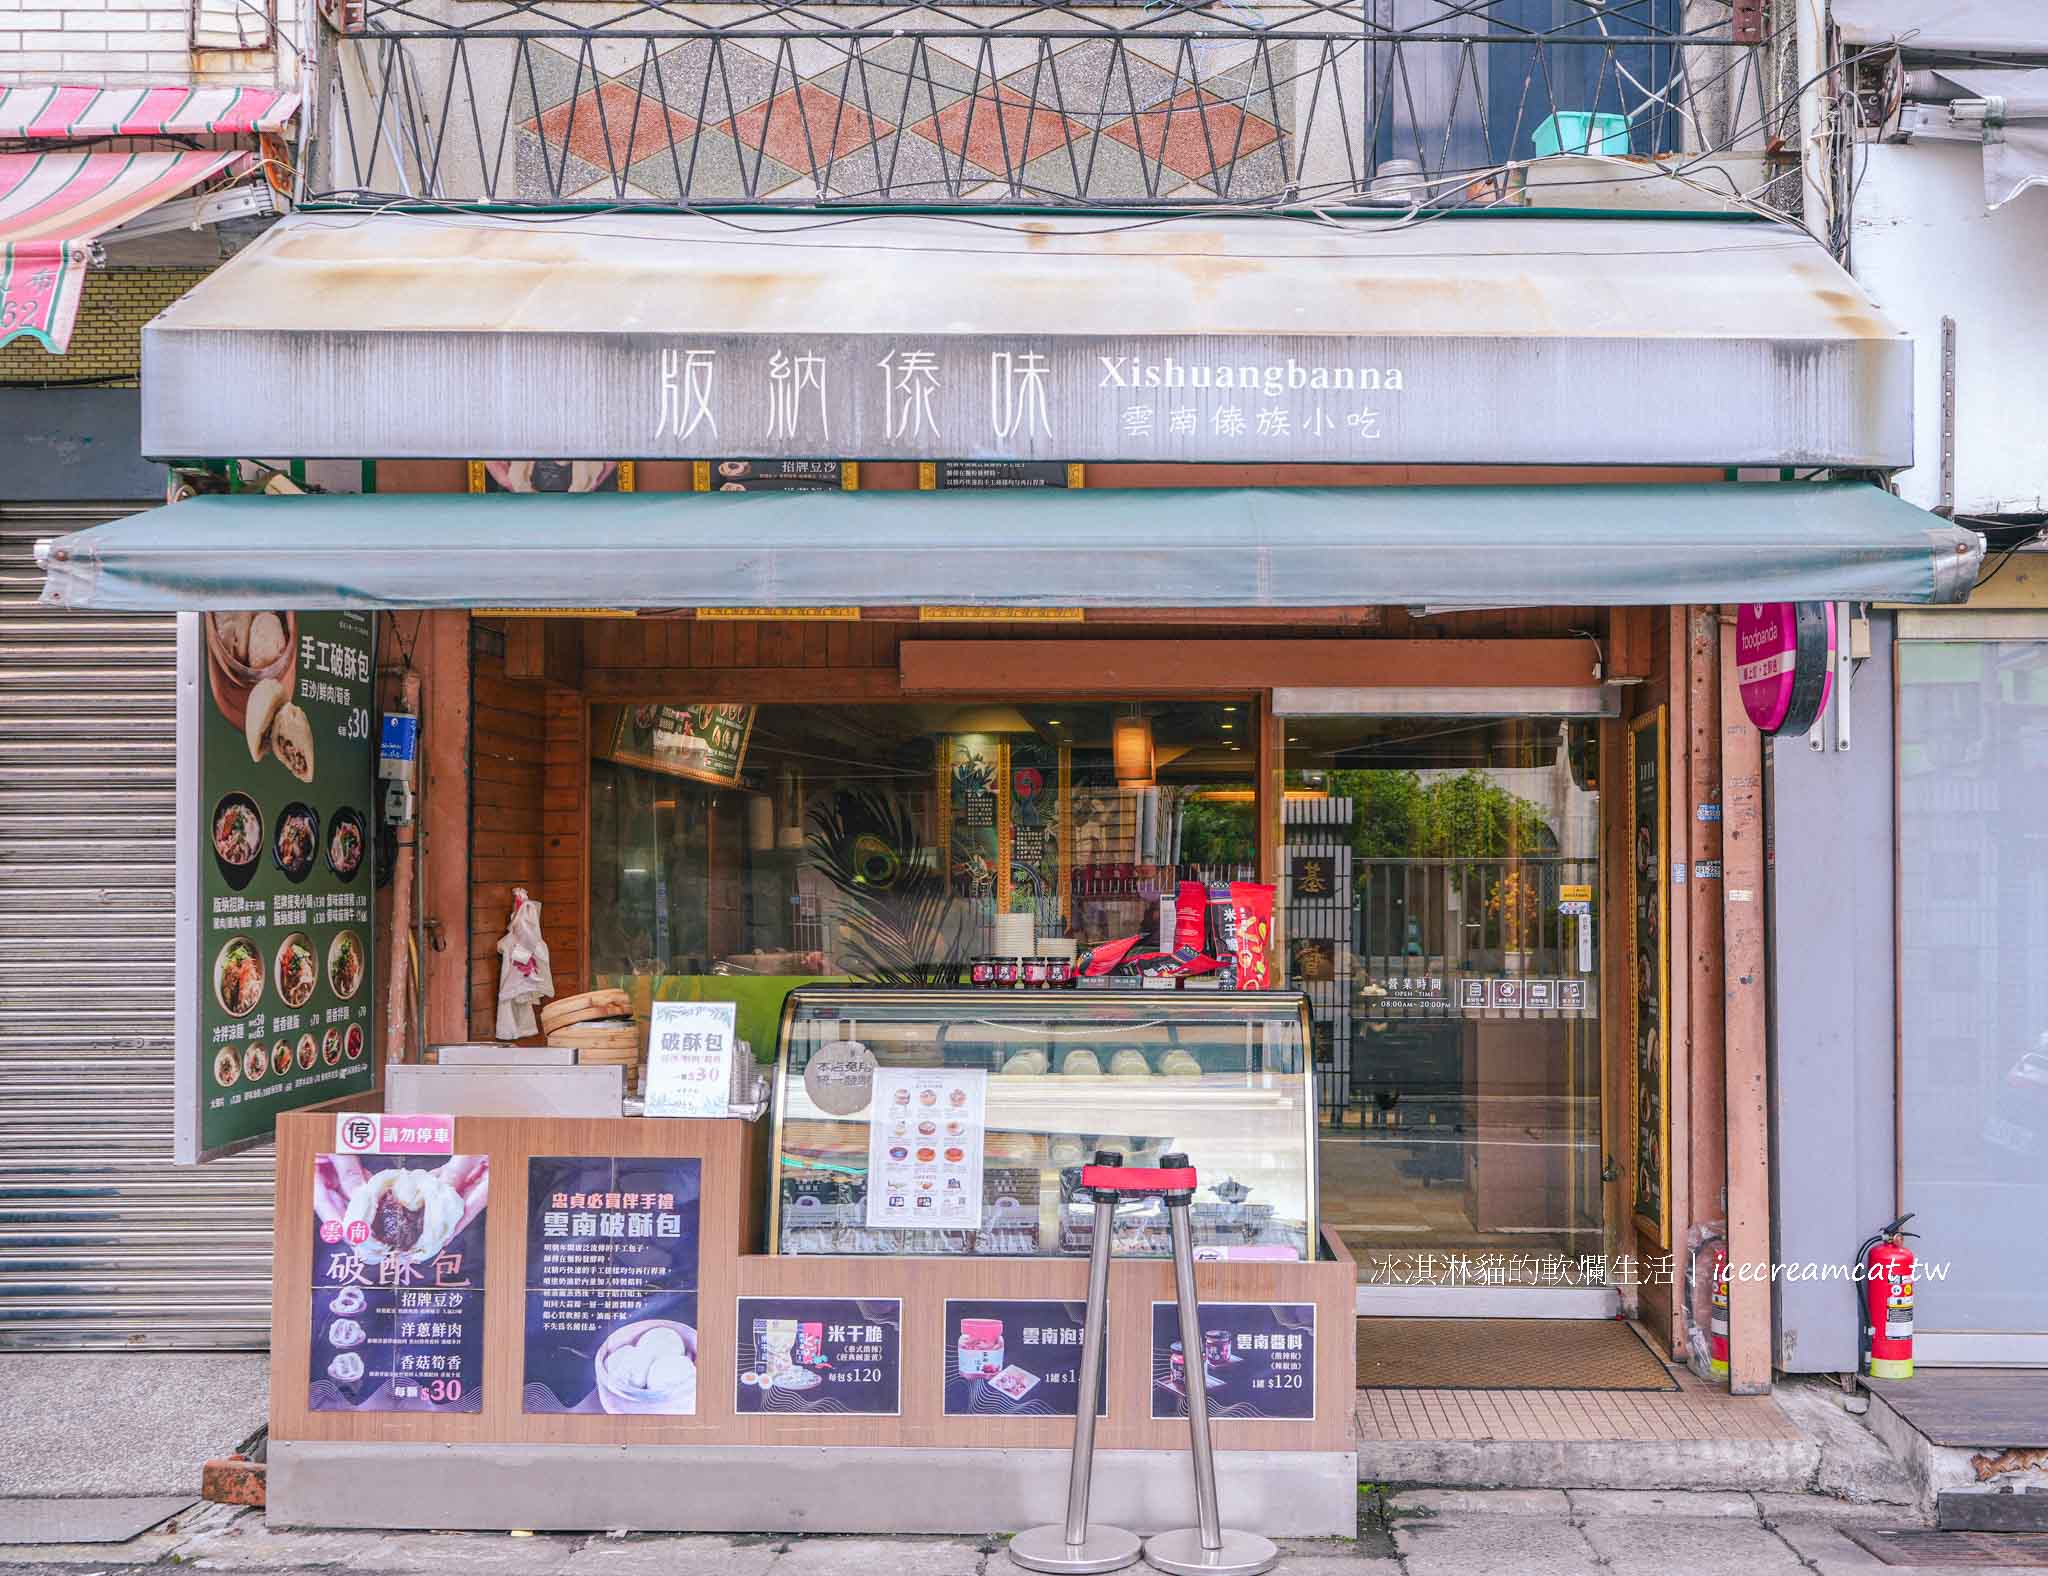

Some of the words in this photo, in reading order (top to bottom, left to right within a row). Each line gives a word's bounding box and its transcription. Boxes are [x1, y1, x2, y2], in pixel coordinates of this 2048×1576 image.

[1098, 357, 1404, 397] Xishuangbanna
[655, 349, 1053, 441] 版納傣味
[1121, 405, 1382, 439] 雲南傣族小吃
[1741, 620, 1778, 652] foodpanda
[301, 635, 369, 683] 手工破酥包
[1388, 978, 1441, 990] 營業時間
[661, 1032, 722, 1052] 破酥包
[348, 1121, 371, 1144] 停
[383, 1128, 449, 1144] 請勿停車
[322, 1222, 367, 1242] 雲南
[544, 1212, 681, 1238] 雲南破酥包
[326, 1250, 472, 1287] 破酥包
[401, 1293, 464, 1308] 招牌豆沙
[828, 1325, 883, 1343] 米干脆
